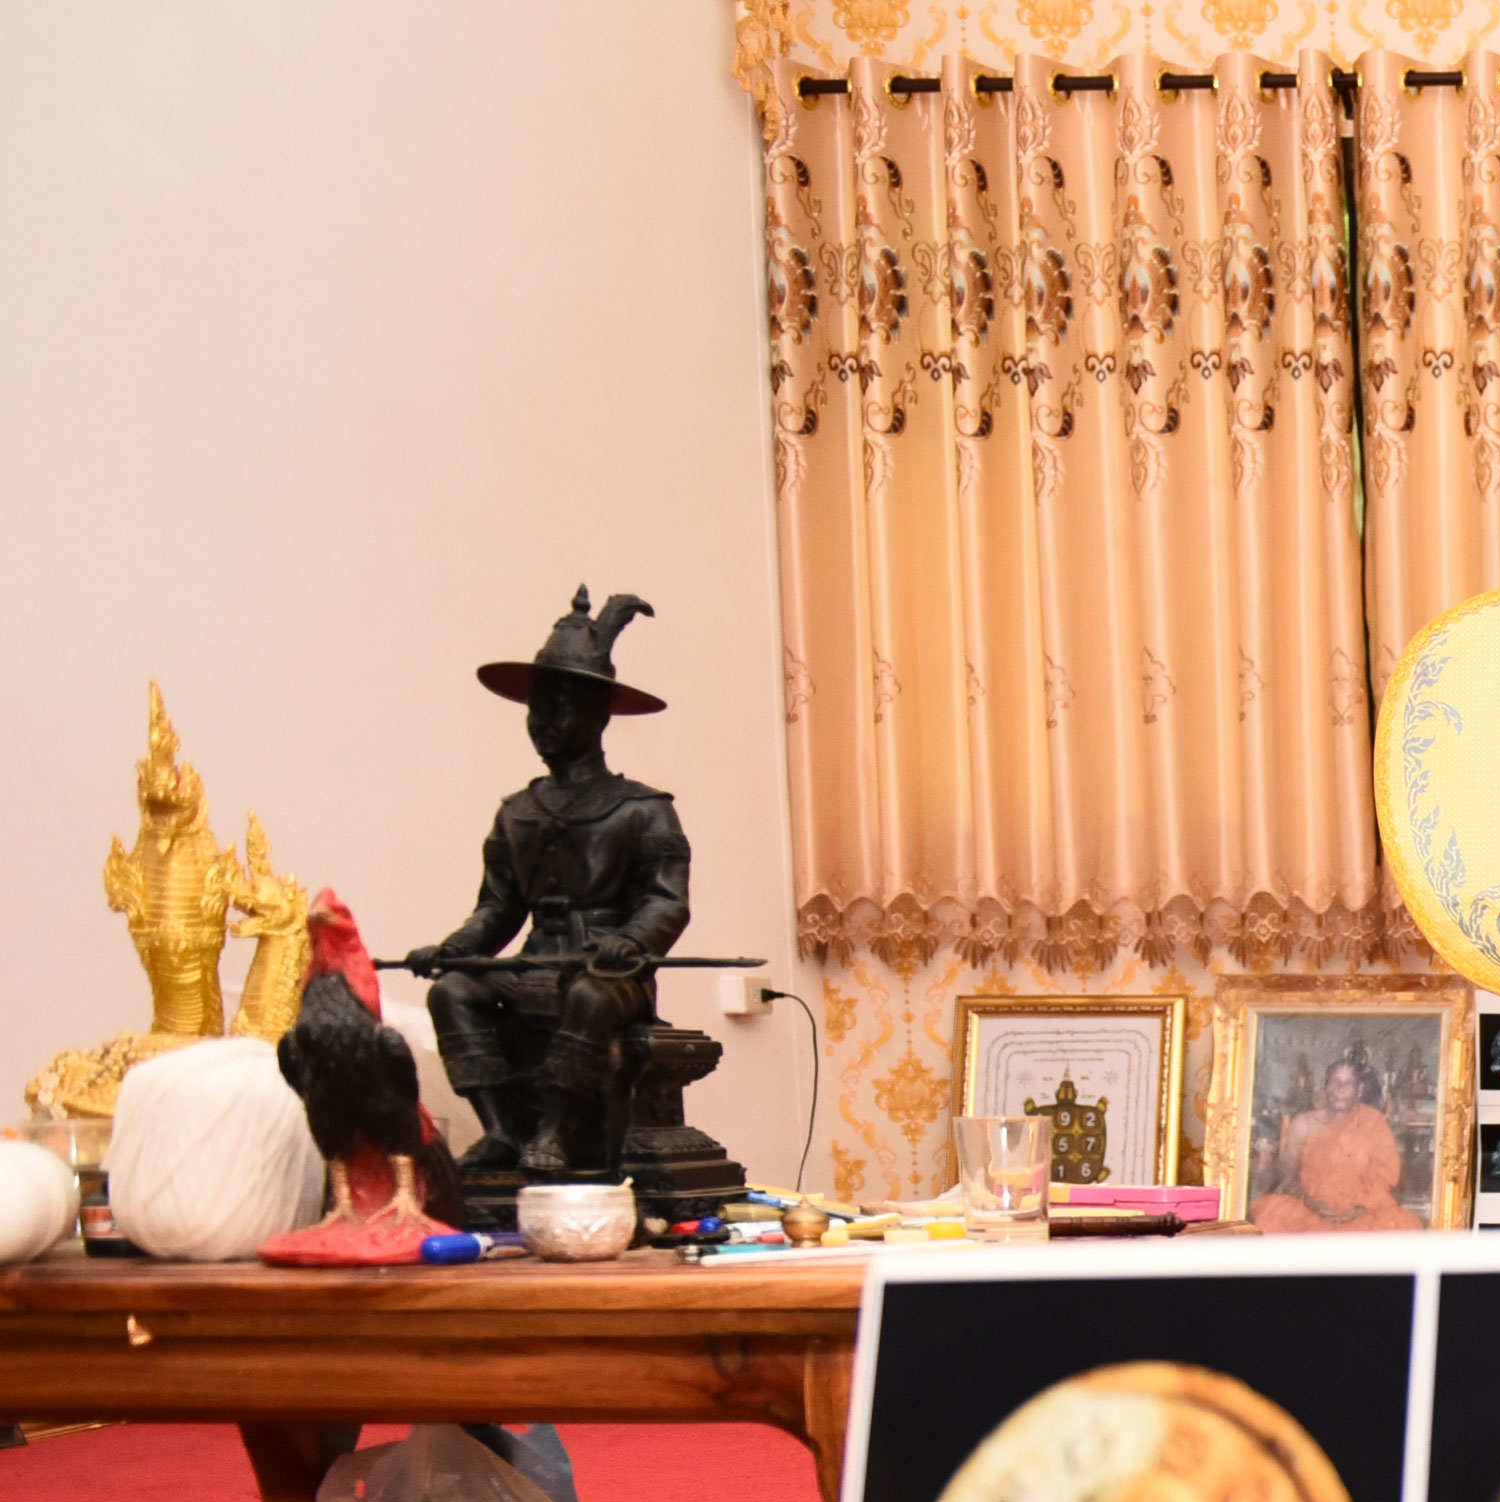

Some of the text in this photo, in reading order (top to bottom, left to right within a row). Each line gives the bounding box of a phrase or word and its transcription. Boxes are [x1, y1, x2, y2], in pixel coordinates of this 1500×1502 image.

[1061, 1112, 1096, 1126] 9 2
[1059, 1138, 1096, 1151] 5 7
[1058, 1164, 1091, 1177] 1 6
